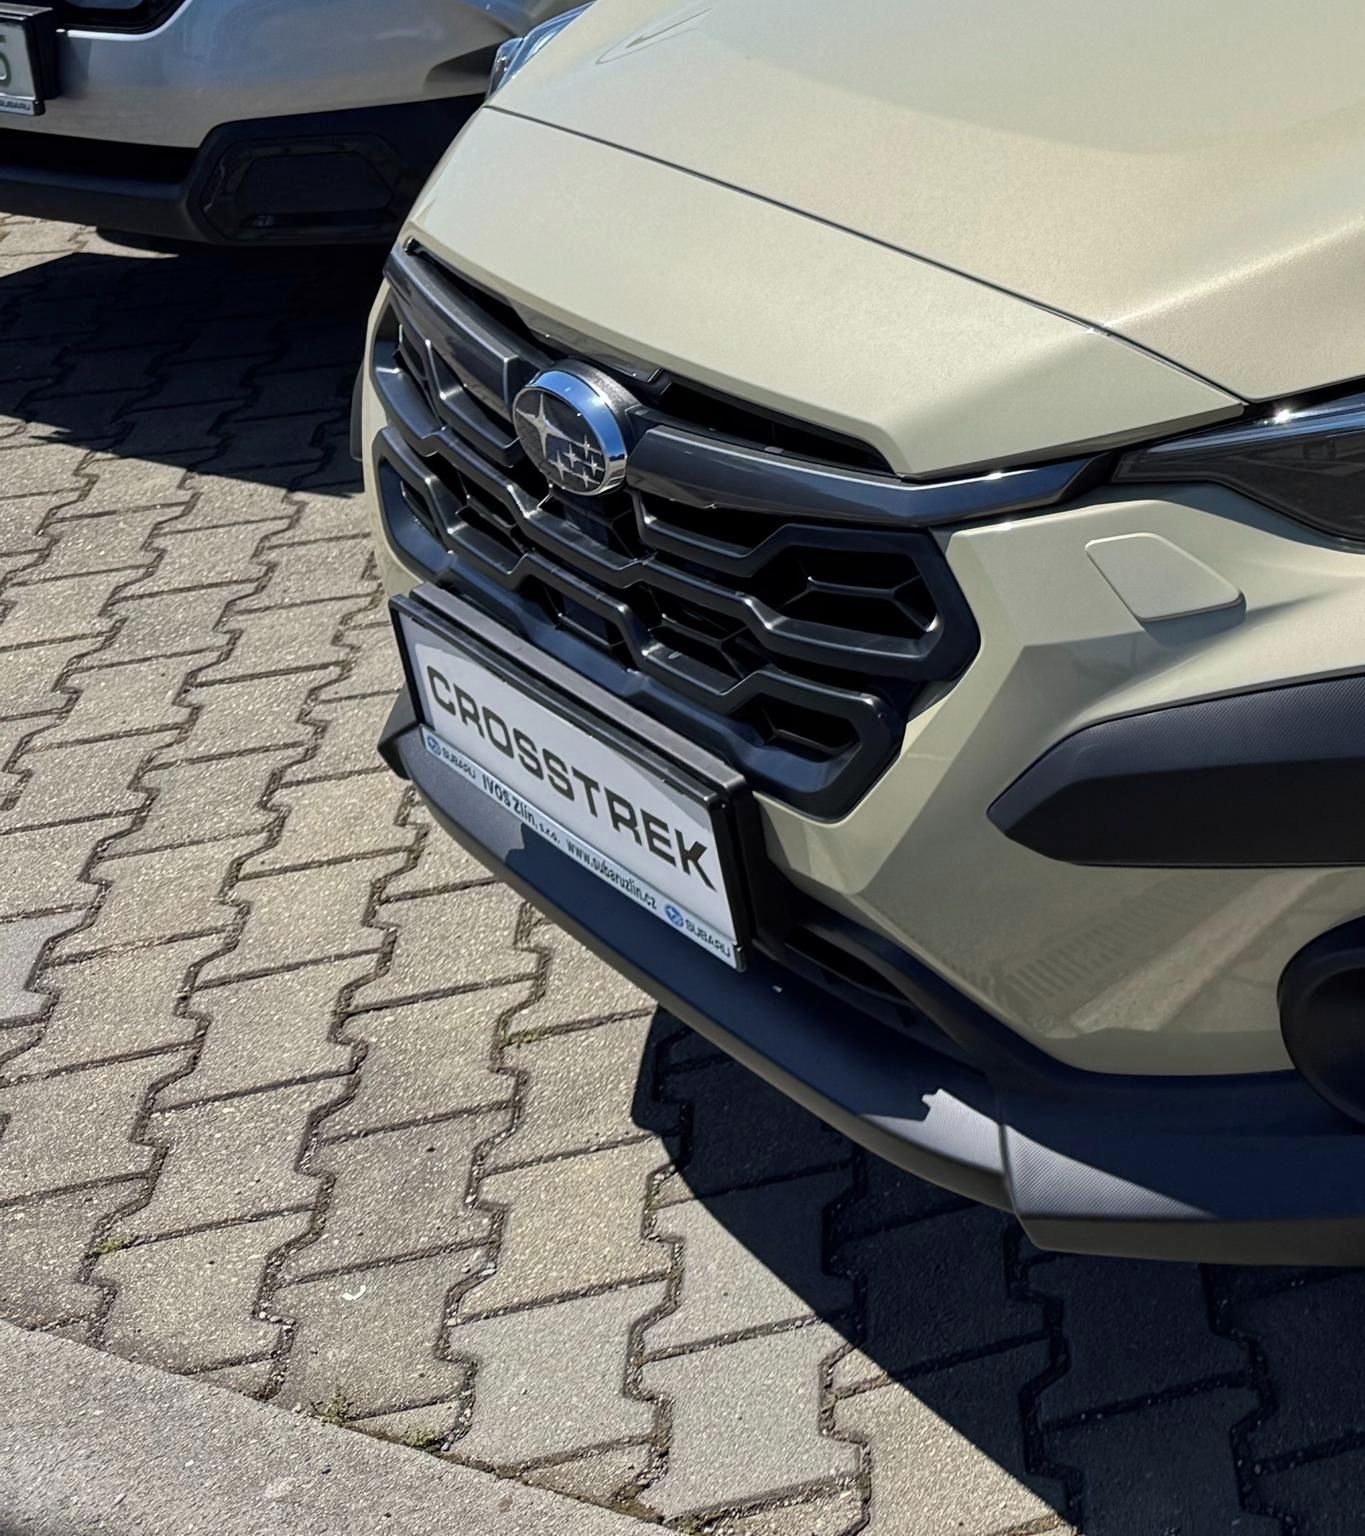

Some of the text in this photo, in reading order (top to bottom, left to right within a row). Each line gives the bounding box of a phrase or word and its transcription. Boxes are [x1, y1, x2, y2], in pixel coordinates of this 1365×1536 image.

[426, 664, 718, 893] CROSSTREK
[441, 747, 477, 780] SUBARU
[482, 773, 512, 808] IVOS
[566, 838, 658, 911] www.subaruzlin.cz
[685, 918, 732, 959] SUBARU
